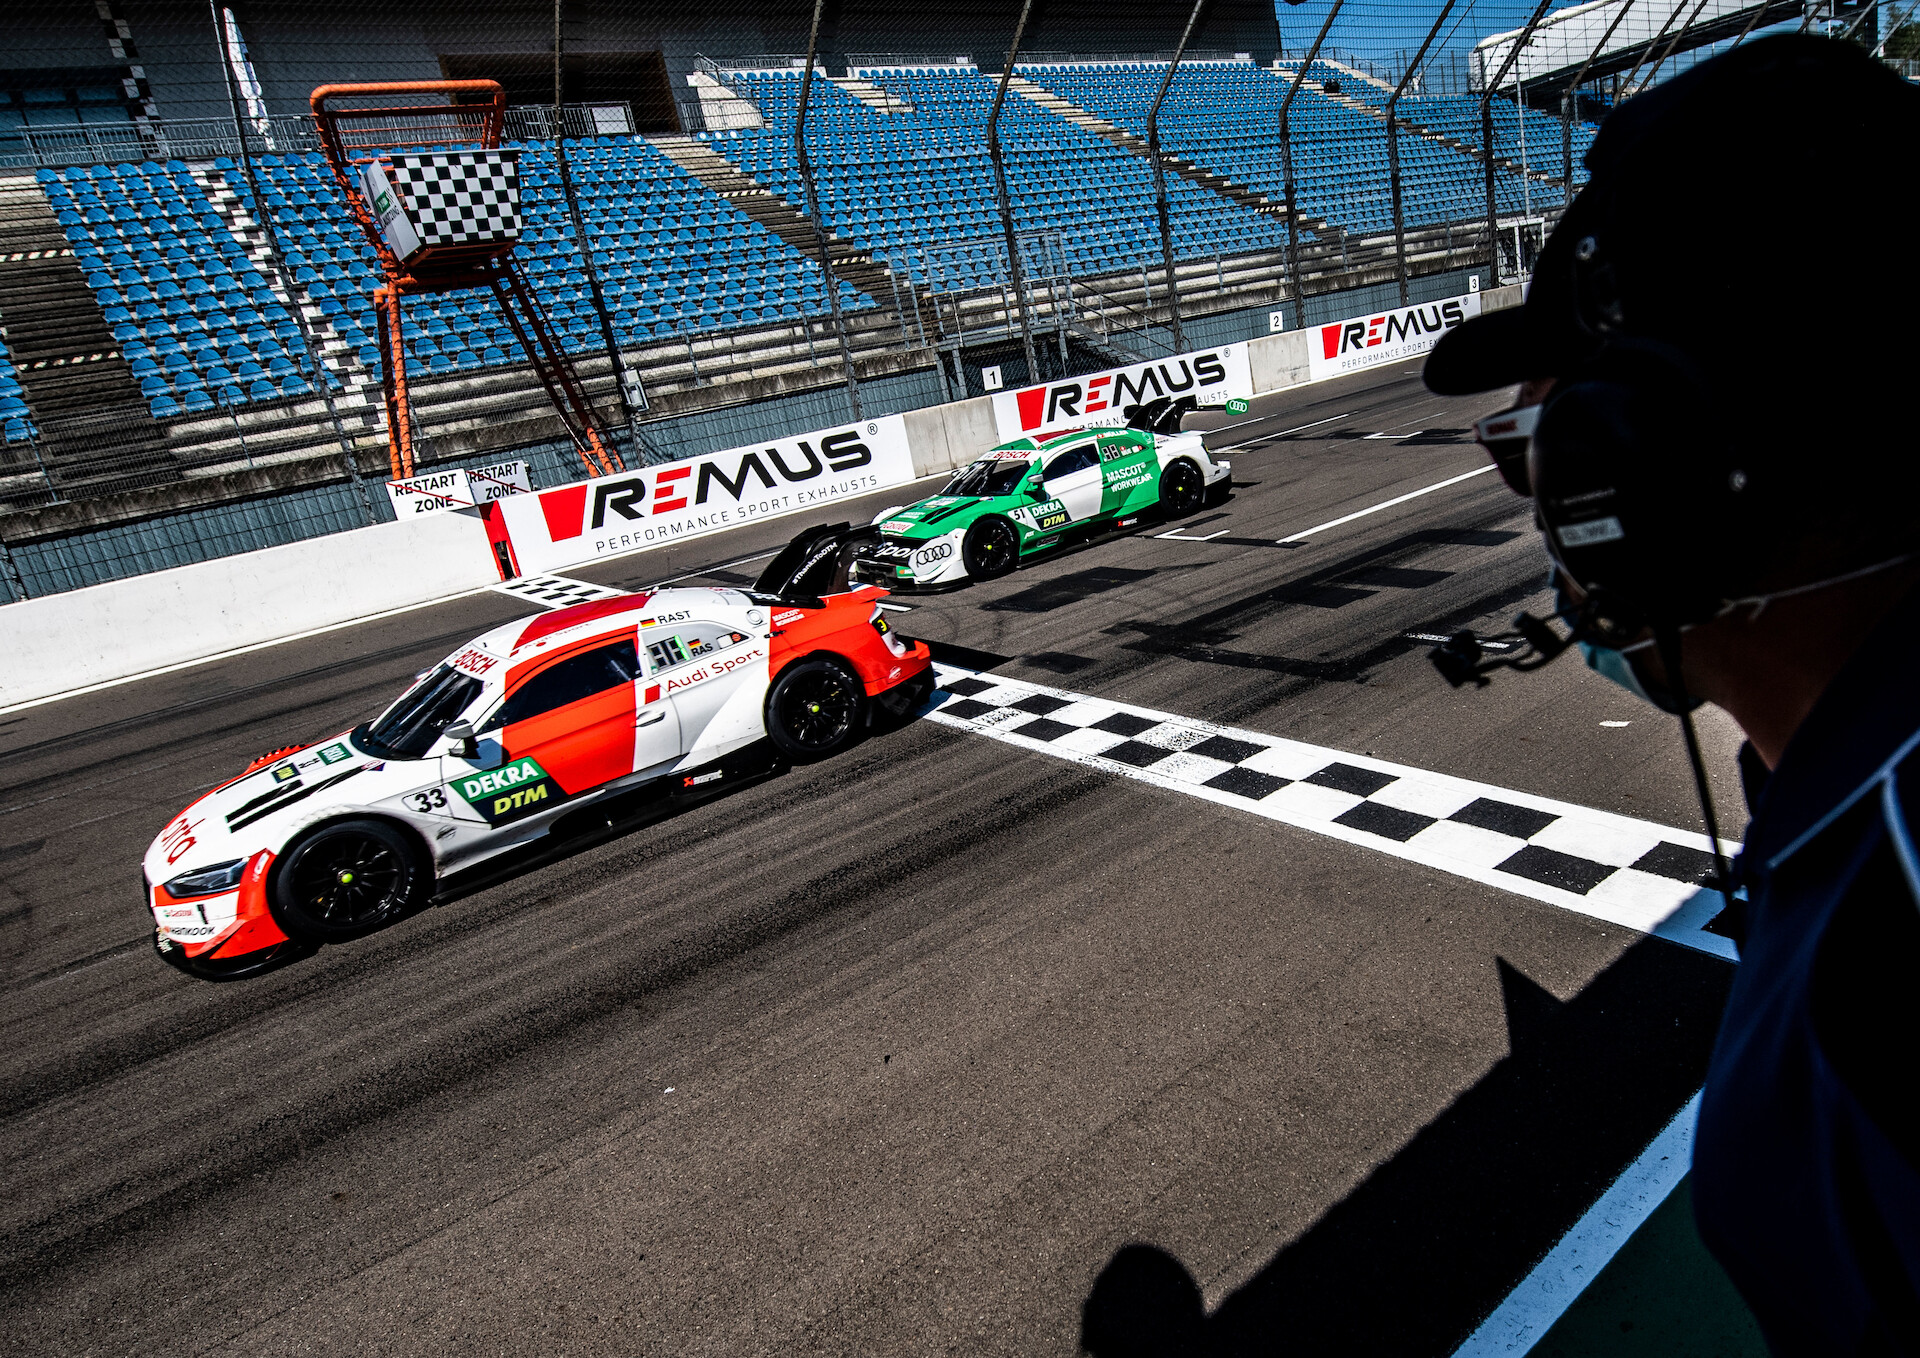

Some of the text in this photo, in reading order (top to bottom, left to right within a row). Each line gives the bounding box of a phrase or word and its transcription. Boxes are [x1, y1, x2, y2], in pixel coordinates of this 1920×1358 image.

[1471, 278, 1478, 289] 3
[1273, 315, 1280, 328] 2
[1341, 347, 1400, 369] PERFORMANCE
[1402, 341, 1427, 355] SPORT
[989, 370, 997, 386] 1
[1197, 389, 1229, 405] AUSTS
[993, 451, 1032, 460] BOSCH
[468, 462, 519, 484] RESTART
[1110, 473, 1153, 493] WORKWEAR
[394, 473, 457, 497] RESTART
[485, 482, 517, 501] ZONE
[414, 494, 454, 514] ZONE
[595, 474, 878, 553] PERFORMANCE SPORT EXHAUSTS
[1031, 501, 1063, 518] DEKRA
[1013, 508, 1026, 521] 51
[1043, 514, 1066, 528] DTM
[791, 541, 838, 585] #ThanksToDTM
[657, 610, 691, 625] RAST
[690, 642, 714, 658] RAS
[454, 649, 499, 675] BOSCH
[667, 649, 763, 692] Audi Sport
[463, 762, 539, 798] DEKRA
[414, 788, 448, 813] 33
[494, 784, 548, 815] DTM
